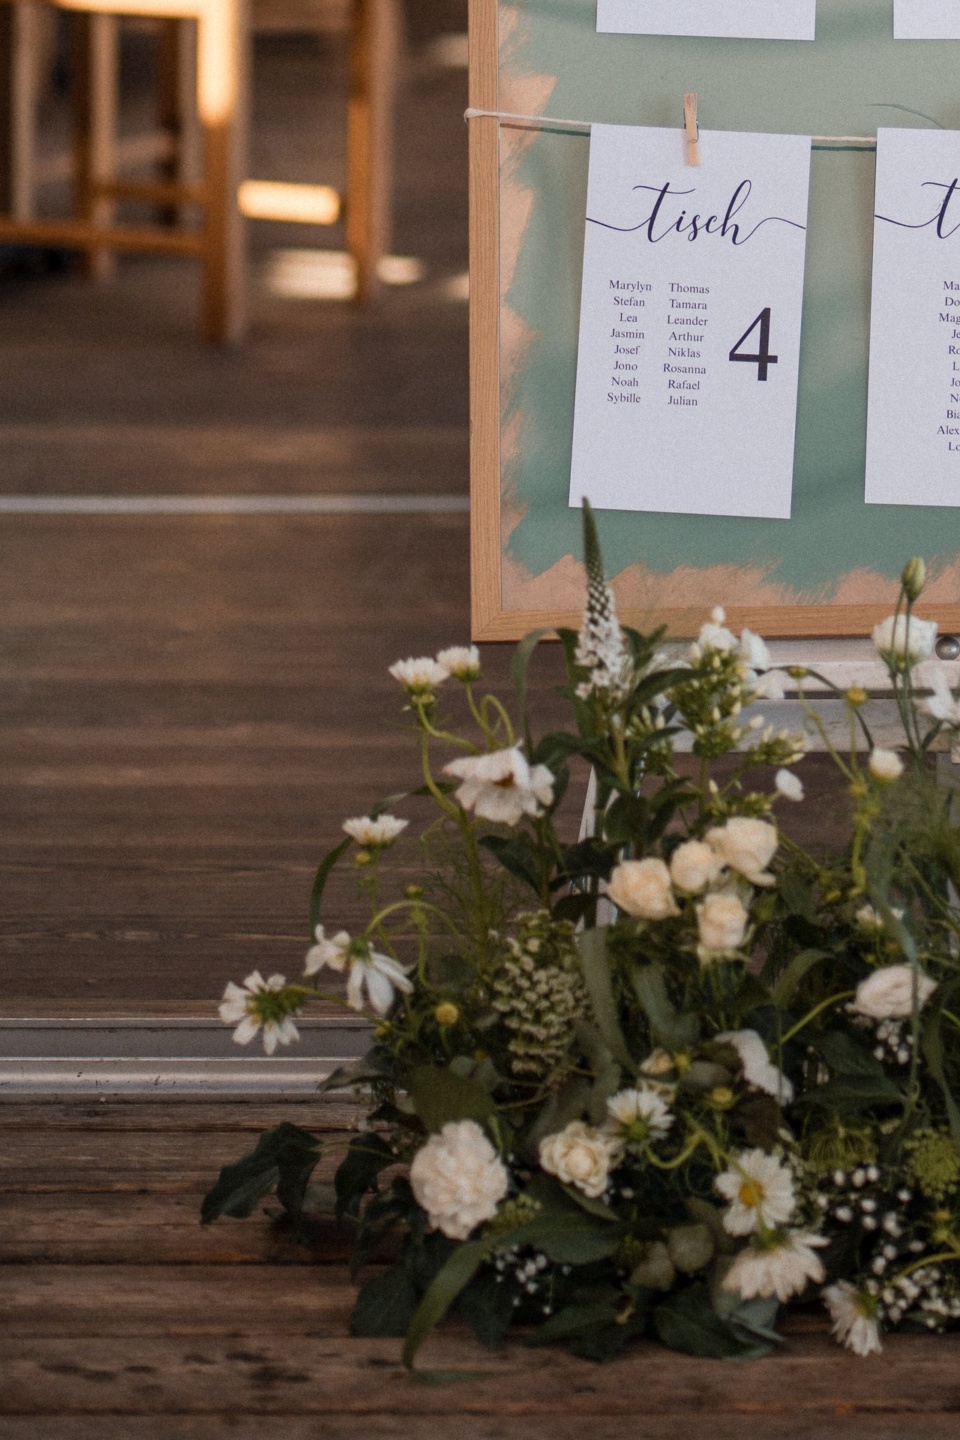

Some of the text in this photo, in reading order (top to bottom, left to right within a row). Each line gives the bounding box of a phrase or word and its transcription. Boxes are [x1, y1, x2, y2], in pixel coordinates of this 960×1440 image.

[668, 282, 710, 294] Thomas
[613, 296, 645, 307] Stefan
[668, 298, 708, 310] Tamara
[619, 312, 638, 323] Lea
[667, 314, 709, 326] Leander
[610, 328, 645, 339] Jasmin
[668, 331, 705, 342] Arthur
[613, 344, 641, 355] Josef
[729, 308, 778, 381] 4
[668, 347, 701, 358] Niklas
[613, 360, 638, 371] Jono
[663, 362, 707, 375] Rosanna
[611, 376, 639, 387] Noah
[668, 379, 700, 391] Rafael
[606, 392, 641, 405] Sybille
[667, 395, 698, 406] Julian
